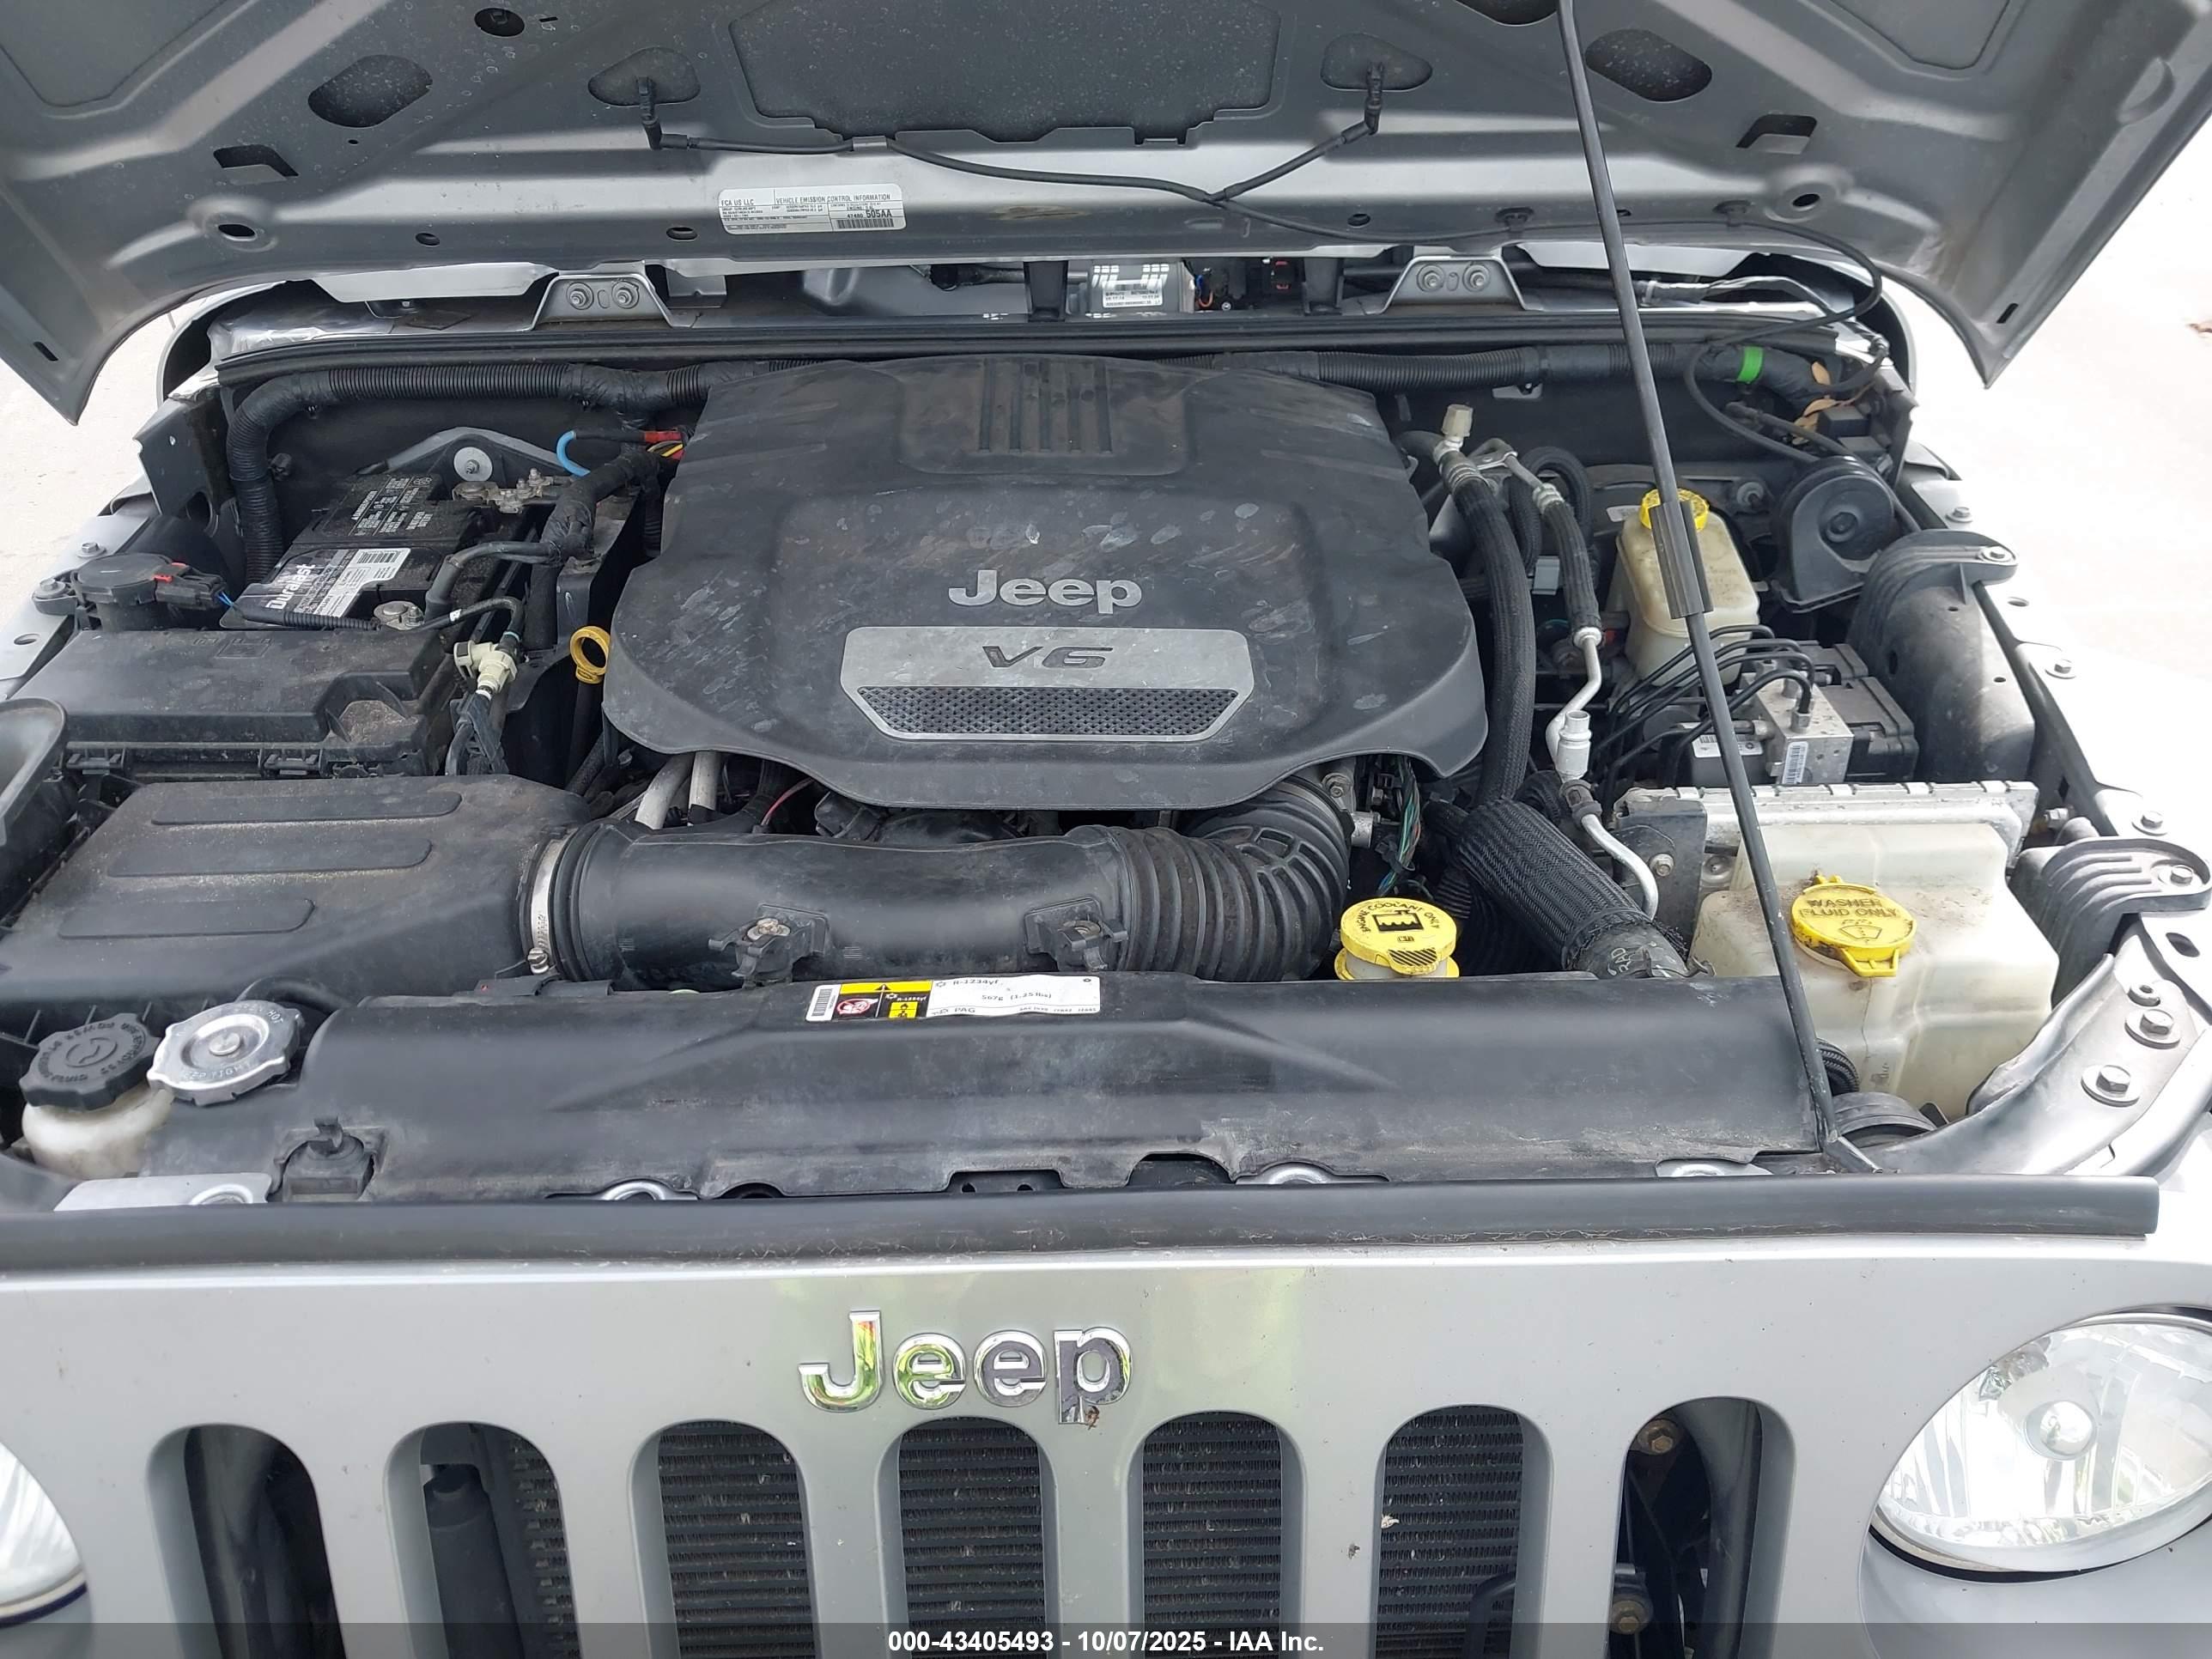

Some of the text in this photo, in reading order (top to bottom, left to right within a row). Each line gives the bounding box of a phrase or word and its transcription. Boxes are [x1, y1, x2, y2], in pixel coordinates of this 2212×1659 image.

[866, 210, 893, 218] 505AA
[265, 563, 316, 610] Duralast
[948, 569, 1142, 614] Jeep
[981, 646, 1114, 668] V6
[1800, 908, 1898, 918] FLUID ONLY
[1807, 898, 1882, 908] WASHER
[1357, 902, 1441, 933] ENGINE COOLANT ONLY
[267, 1009, 284, 1024] HOT
[798, 1310, 1133, 1424] Jeep
